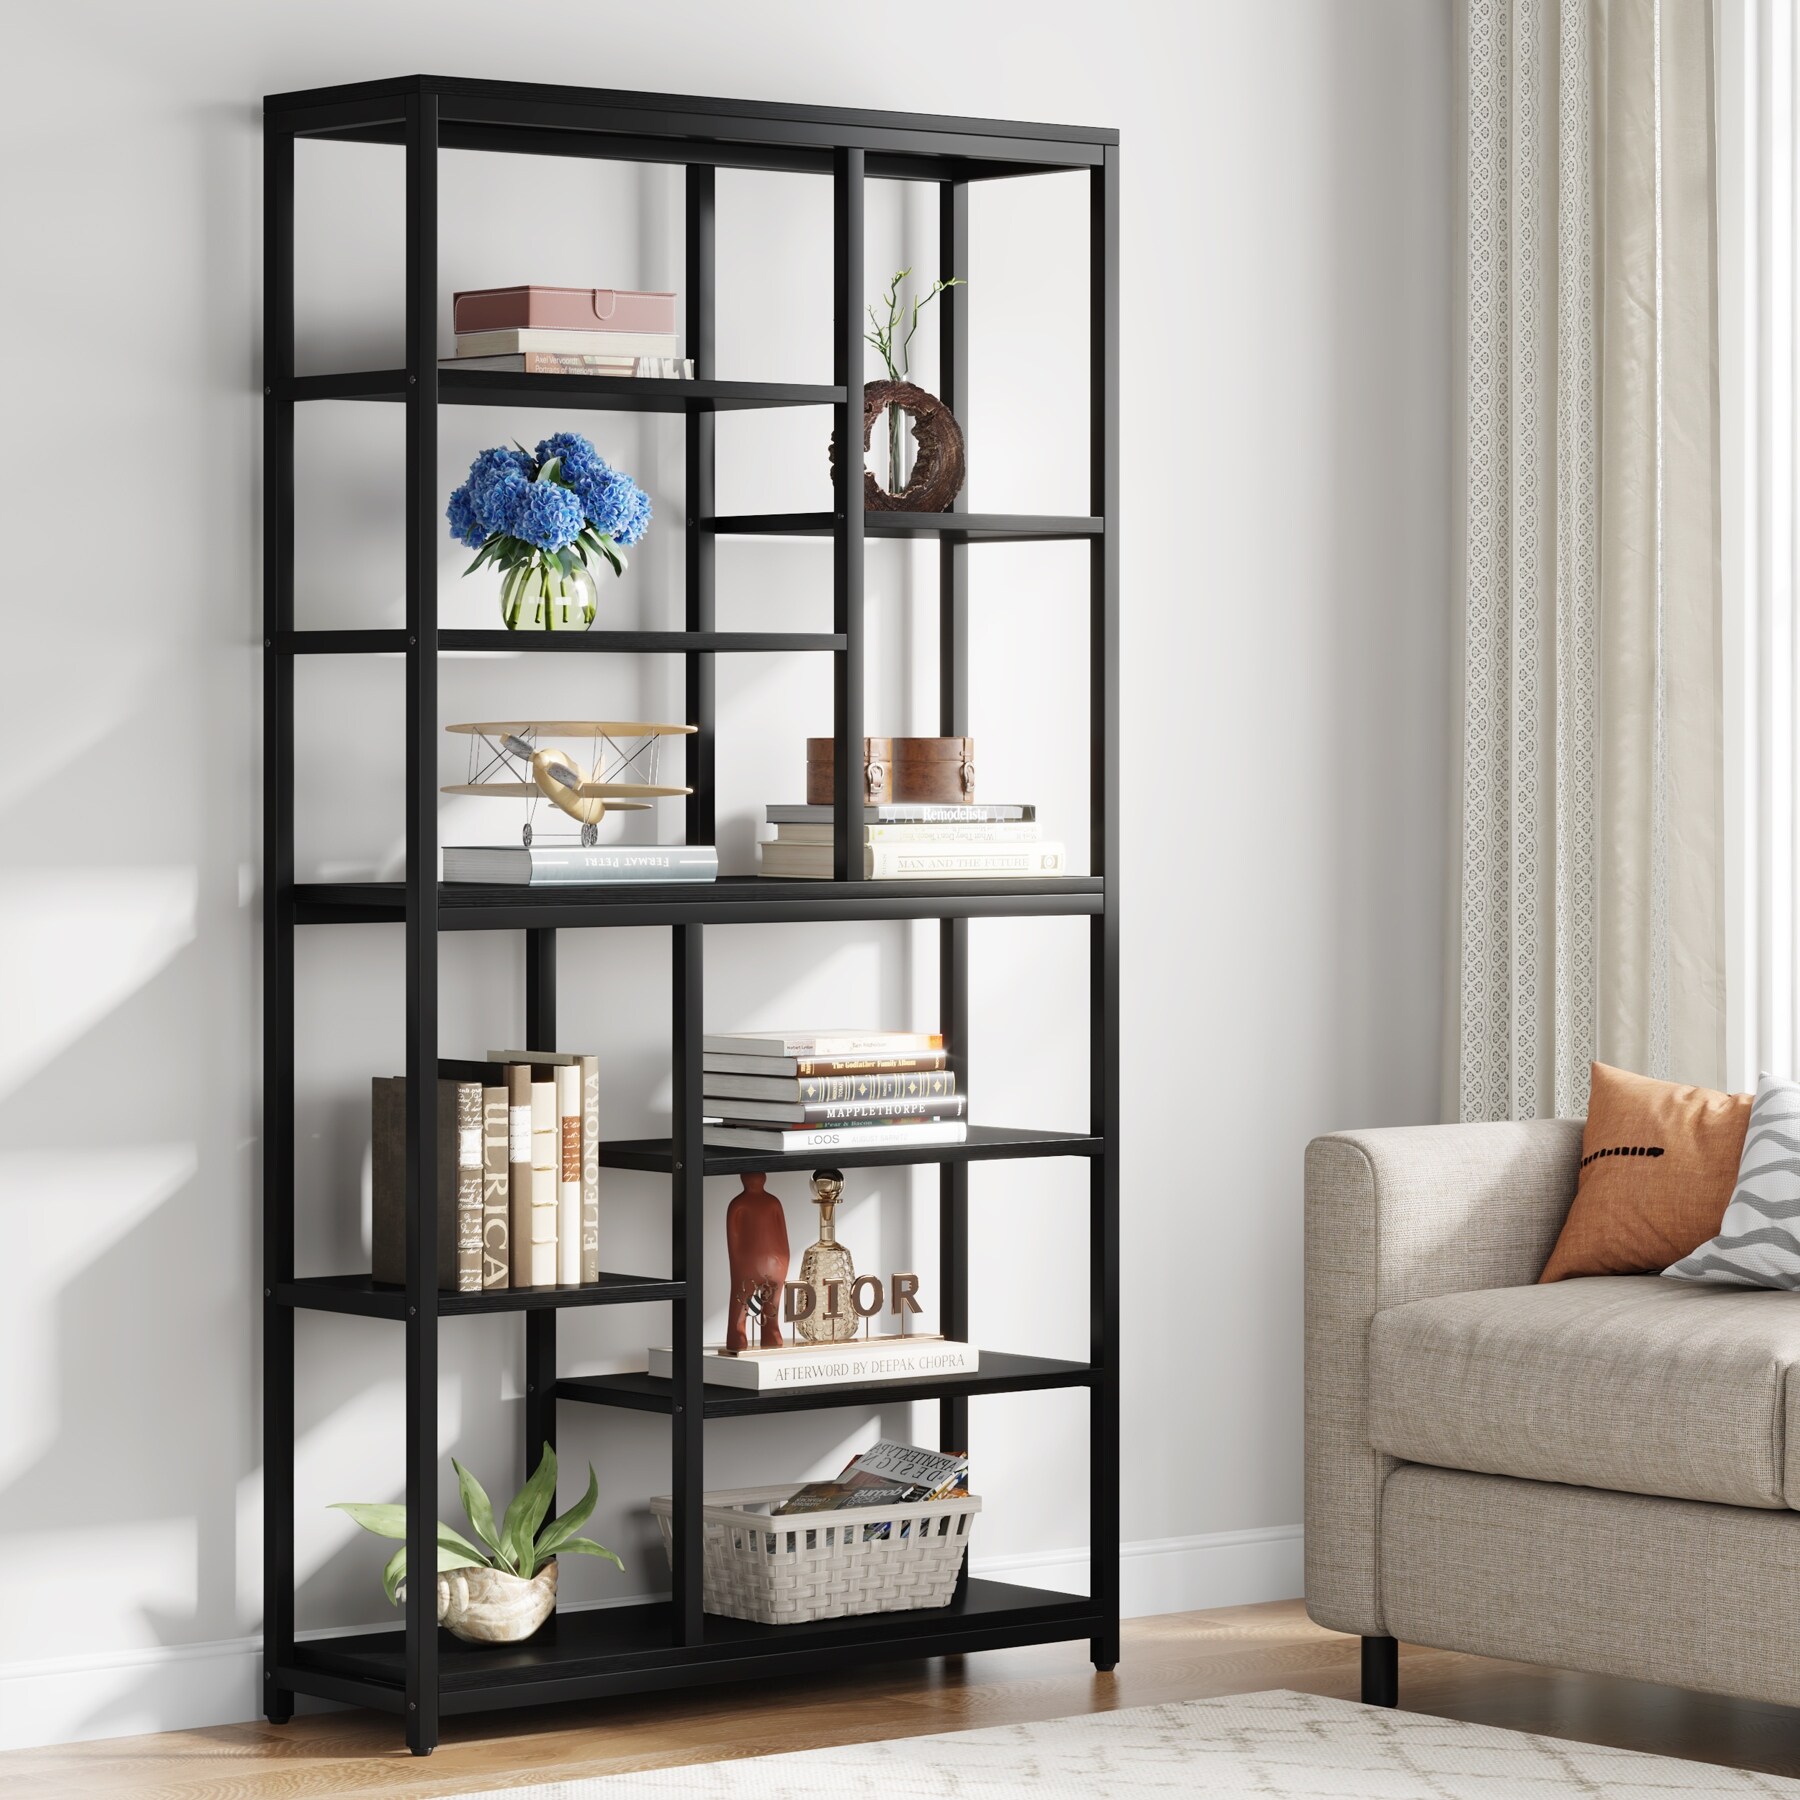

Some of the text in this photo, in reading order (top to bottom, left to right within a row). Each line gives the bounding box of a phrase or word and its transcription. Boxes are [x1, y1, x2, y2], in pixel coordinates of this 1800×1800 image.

[535, 355, 578, 365] Axel Vervoordt
[535, 366, 560, 374] Portraits
[568, 367, 593, 376] Interiors
[922, 806, 988, 821] Remodelista
[585, 857, 670, 868] FERMAT PETRI
[899, 857, 924, 869] MAN
[929, 857, 953, 868] AND
[957, 856, 982, 868] THE
[984, 855, 1029, 867] FUTURE
[832, 1061, 845, 1070] The
[826, 1103, 926, 1119] MAPPLETHORPE
[807, 1134, 840, 1146] LOOS
[583, 1071, 599, 1252] ELEONORA
[484, 1102, 509, 1287] ULRICA
[783, 1272, 924, 1323] DIOR
[775, 1353, 965, 1382] AFTERWORD BY DEEPAK CHOPRA
